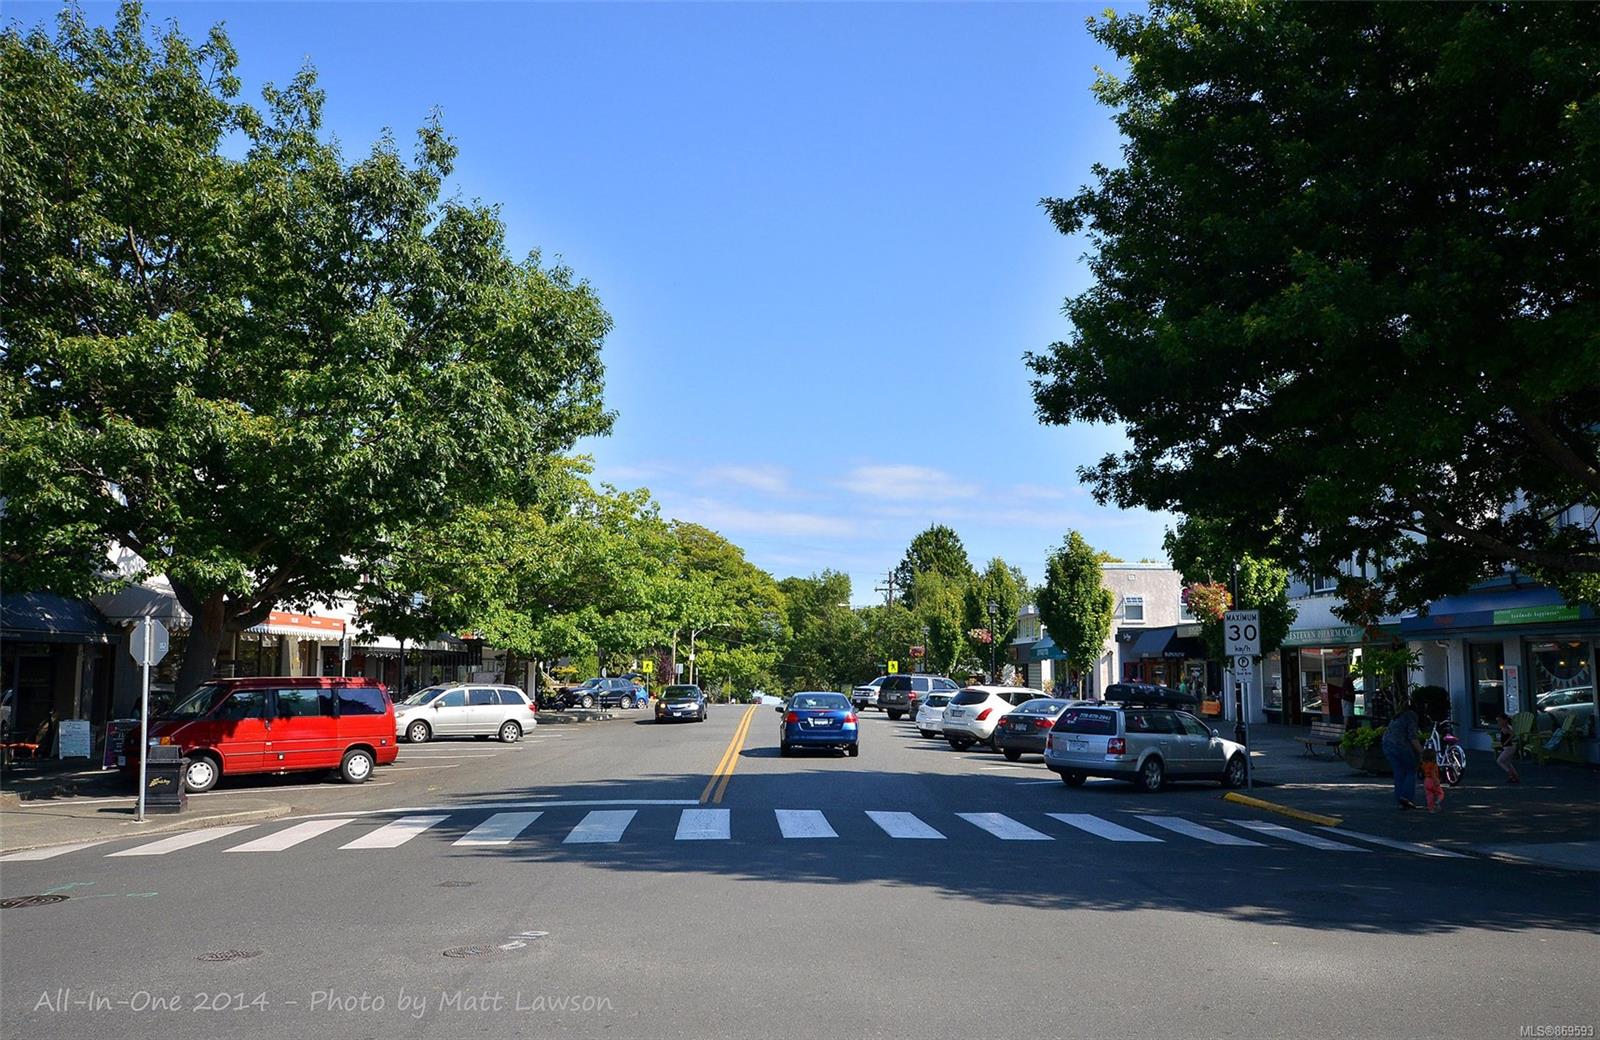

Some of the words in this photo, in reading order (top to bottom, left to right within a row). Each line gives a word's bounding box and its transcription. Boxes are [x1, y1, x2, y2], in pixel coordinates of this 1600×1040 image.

[1226, 613, 1257, 621] MAXIMUM
[1228, 624, 1257, 641] 30
[1289, 630, 1316, 640] ESTEVAN
[1317, 627, 1355, 639] PHARMACY
[1234, 644, 1251, 653] km/h
